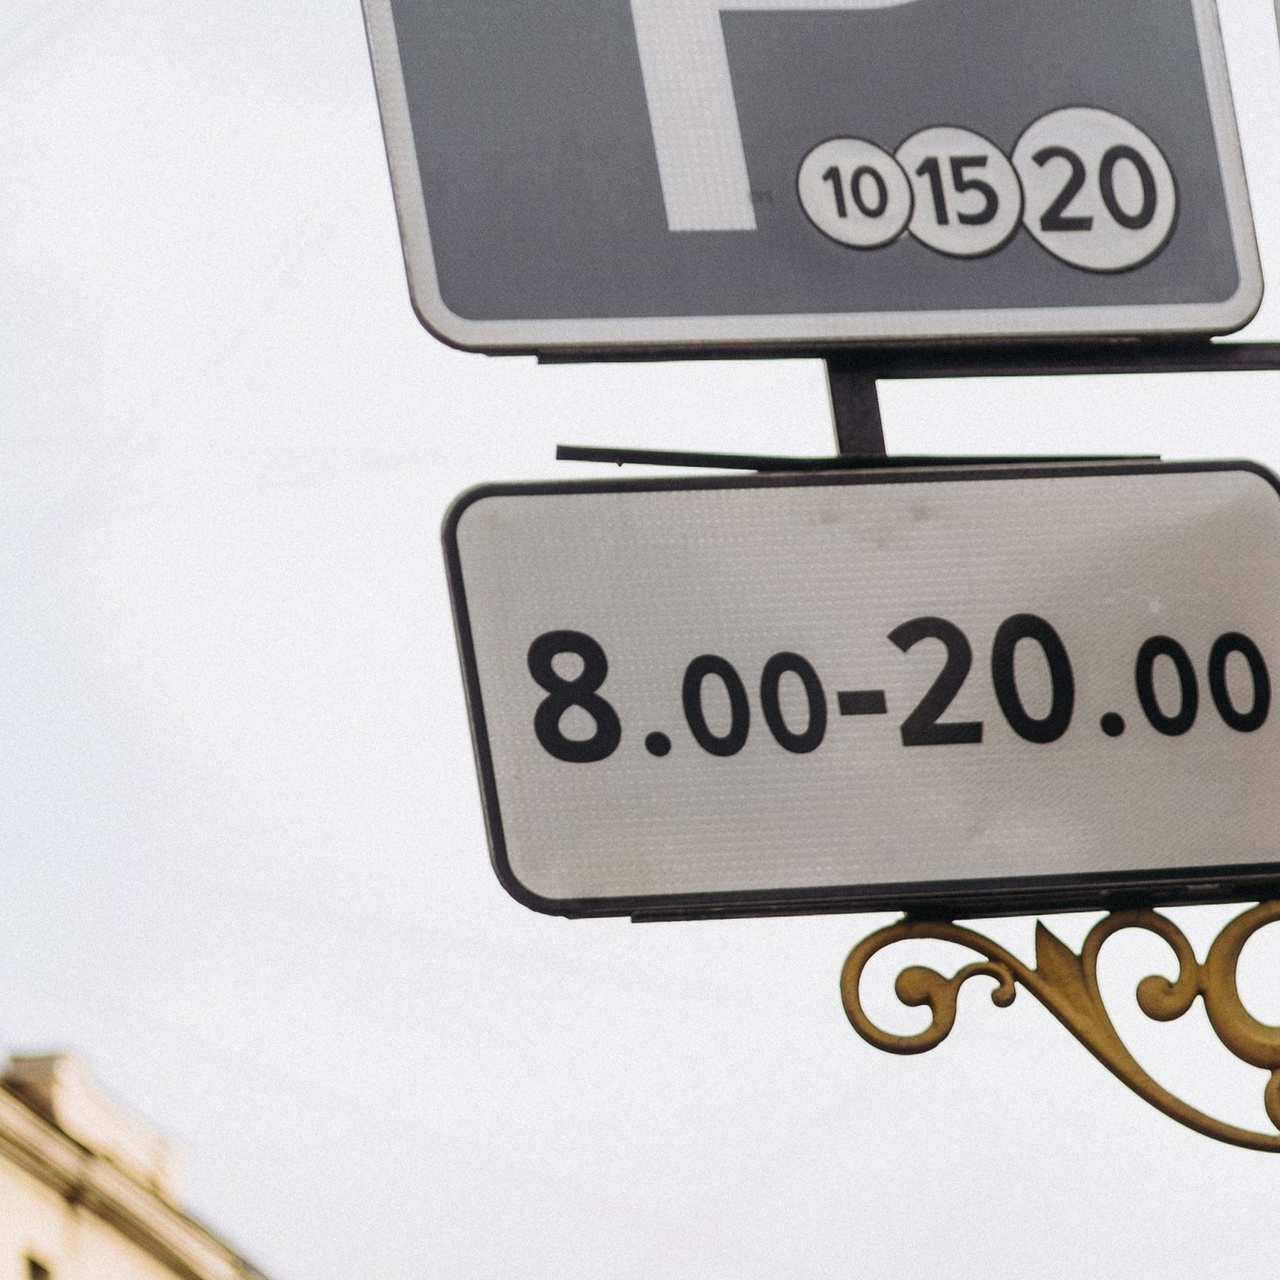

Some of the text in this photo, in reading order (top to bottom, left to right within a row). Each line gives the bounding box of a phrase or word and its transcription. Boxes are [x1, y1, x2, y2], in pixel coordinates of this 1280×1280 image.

[822, 145, 1157, 232] 10 15 20
[527, 613, 1272, 764] 8.00-20.00
